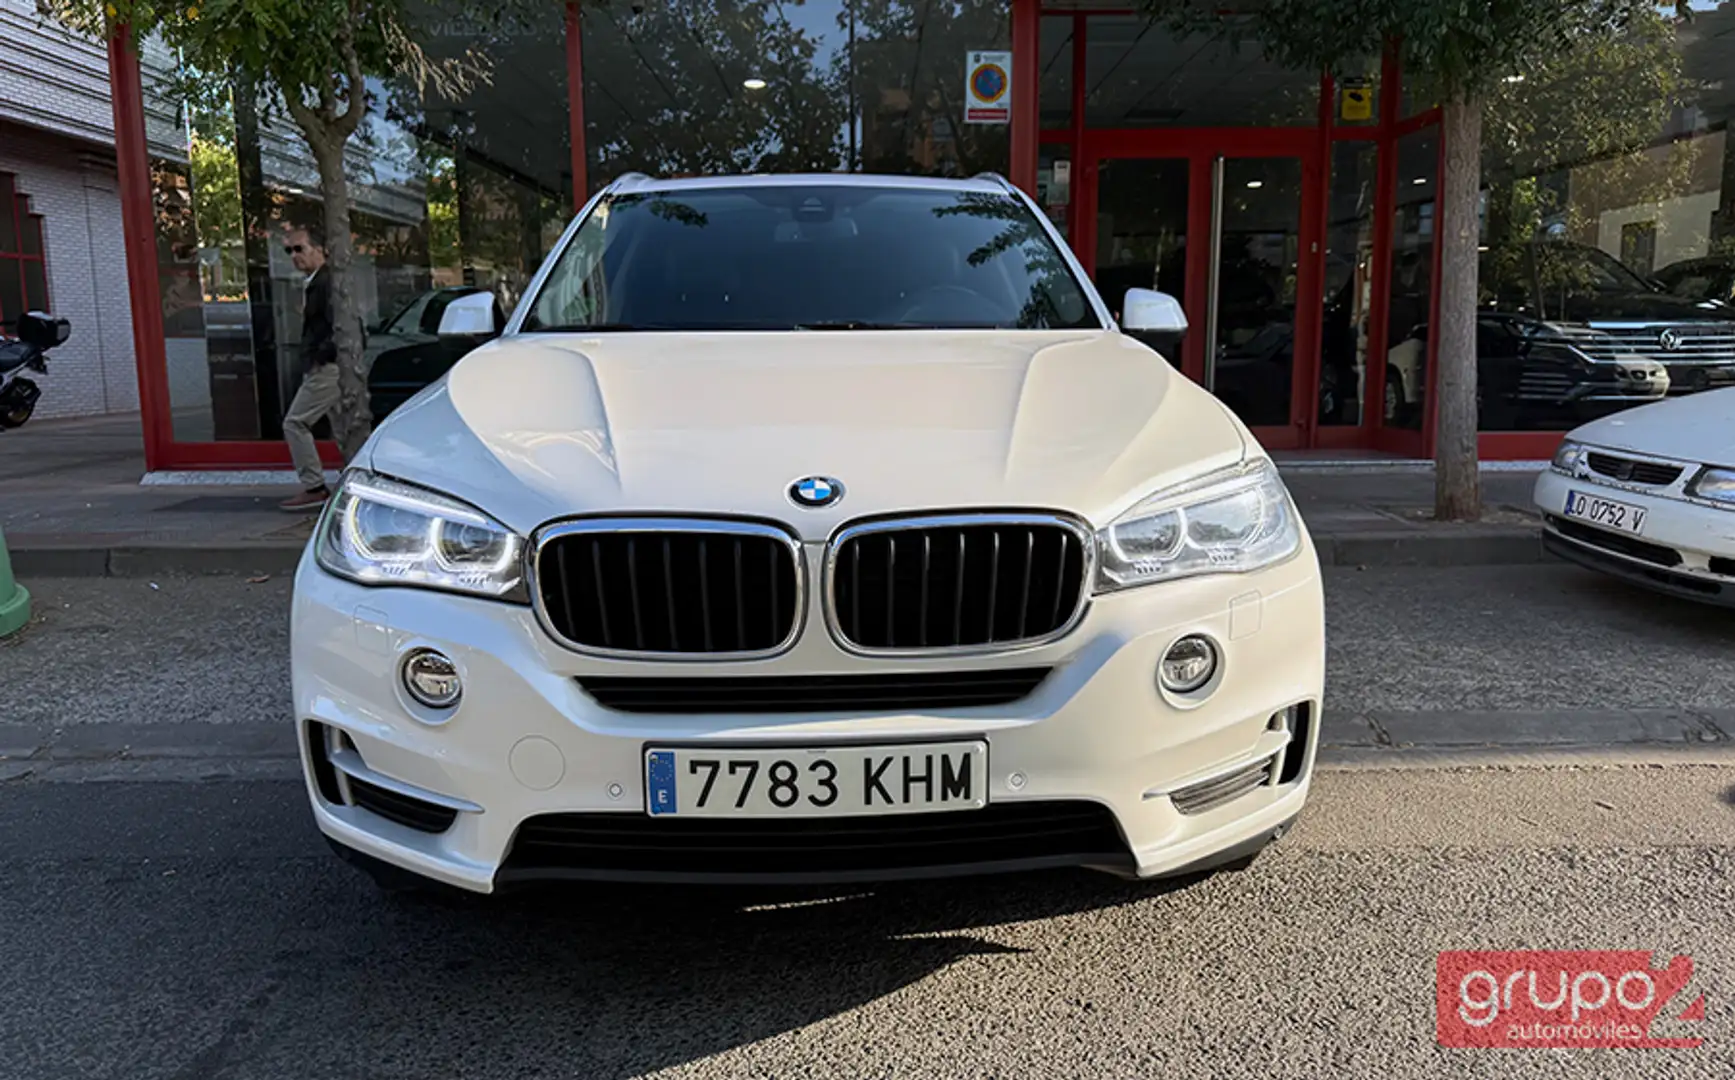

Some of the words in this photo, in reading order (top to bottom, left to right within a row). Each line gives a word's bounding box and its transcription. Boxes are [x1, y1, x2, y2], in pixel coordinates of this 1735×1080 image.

[1590, 500, 1626, 527] 0752
[1632, 510, 1645, 531] V
[689, 759, 839, 809] 7783
[863, 752, 972, 806] KHM
[656, 789, 669, 804] E
